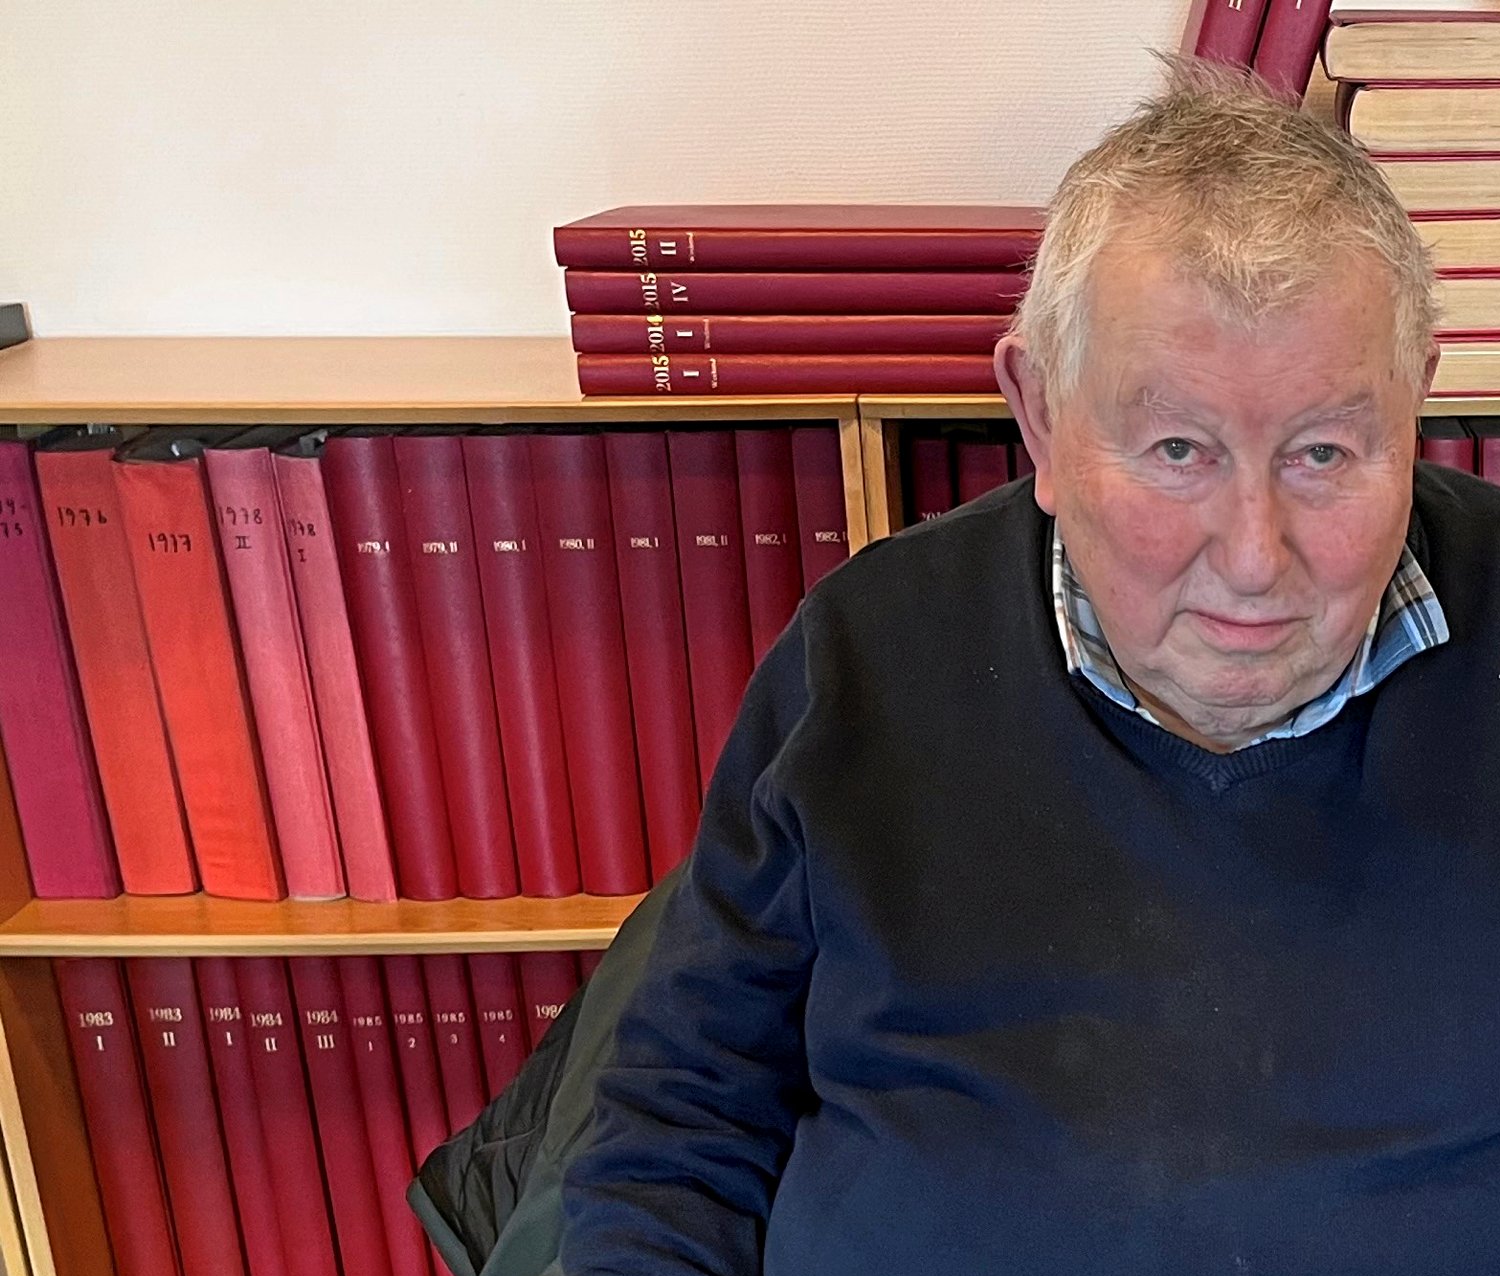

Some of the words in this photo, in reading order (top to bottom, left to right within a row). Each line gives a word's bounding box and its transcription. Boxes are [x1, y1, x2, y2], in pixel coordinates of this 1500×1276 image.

[629, 228, 649, 266] 2015
[659, 241, 677, 255] II
[640, 272, 660, 309] 2015
[670, 281, 689, 302] IV
[676, 330, 693, 338] I
[652, 355, 671, 392] 2015
[57, 507, 108, 527] 1976
[219, 506, 263, 525] 1978
[235, 535, 252, 550] II
[78, 1012, 114, 1028] 1983
[149, 1007, 183, 1022] 1983
[251, 1012, 283, 1028] 1984
[306, 1010, 338, 1025] 1984
[96, 1035, 105, 1050] I
[162, 1032, 176, 1047] II
[225, 1031, 233, 1045] I
[265, 1037, 278, 1052] II
[317, 1034, 335, 1049] III
[408, 1037, 417, 1049] 2
